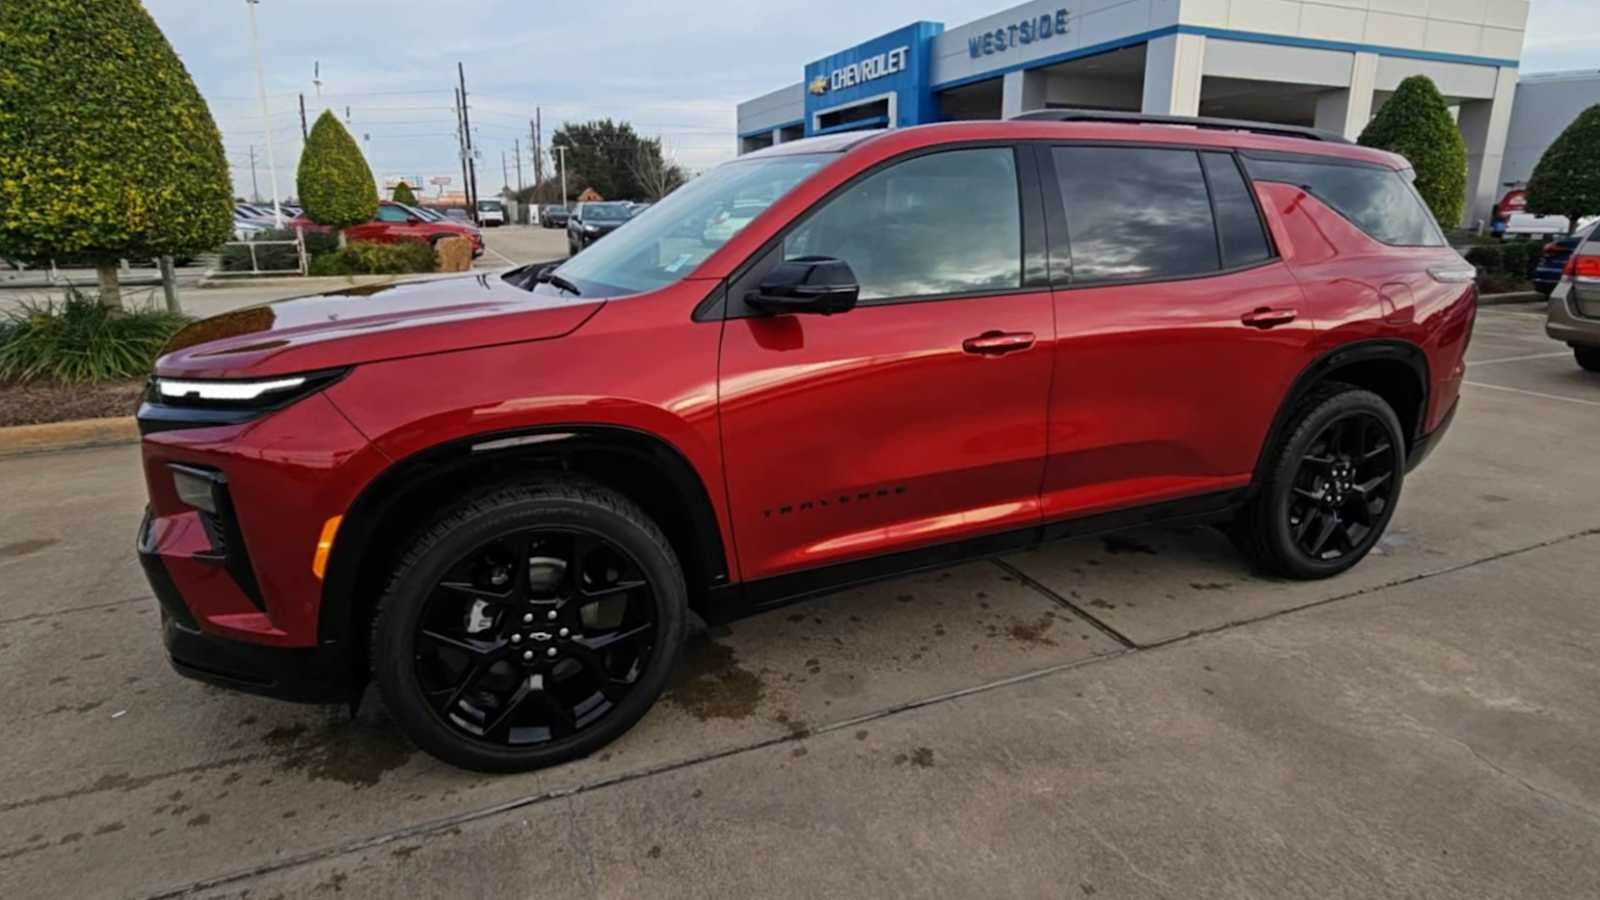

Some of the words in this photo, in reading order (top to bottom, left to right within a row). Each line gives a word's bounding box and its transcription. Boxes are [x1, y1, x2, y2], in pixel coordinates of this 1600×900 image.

[968, 8, 1070, 58] WESTSIDE
[830, 46, 910, 90] CHEVROLET
[763, 486, 907, 518] TRAVERSE
